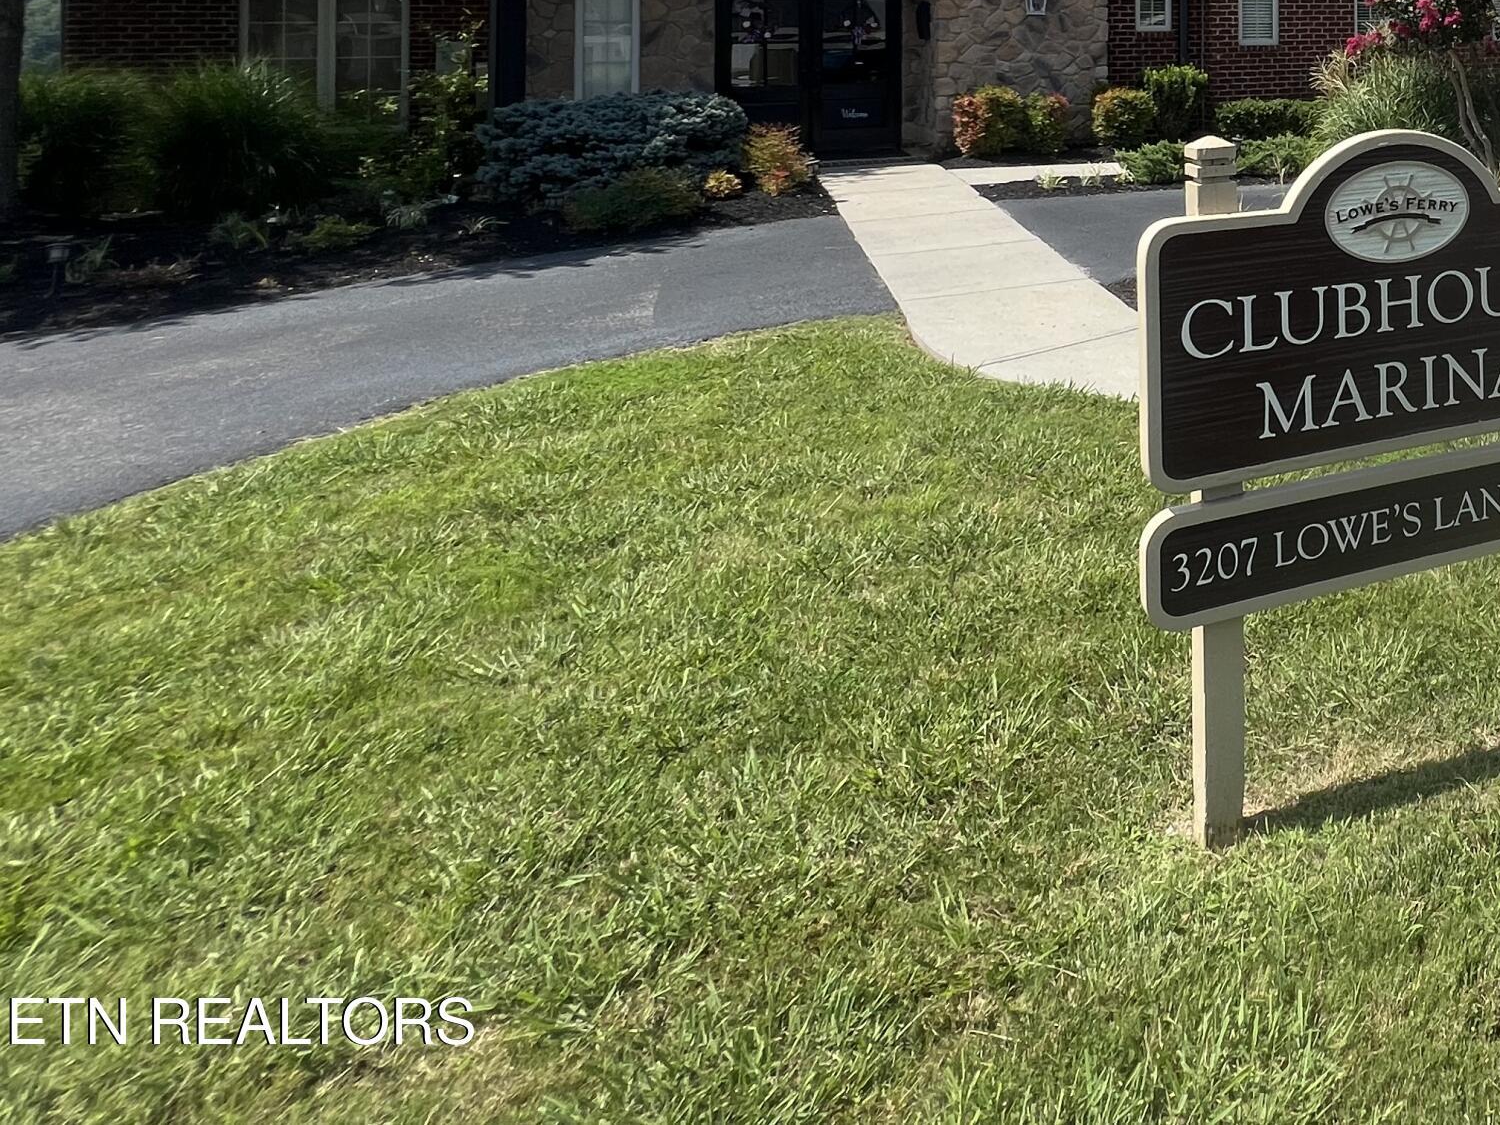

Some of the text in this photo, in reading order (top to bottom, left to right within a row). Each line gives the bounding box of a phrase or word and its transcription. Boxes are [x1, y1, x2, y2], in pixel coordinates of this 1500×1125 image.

[1336, 196, 1459, 224] LOWE'S FERRY
[1170, 536, 1259, 593] 3207
[1274, 502, 1423, 568] LOWE'S
